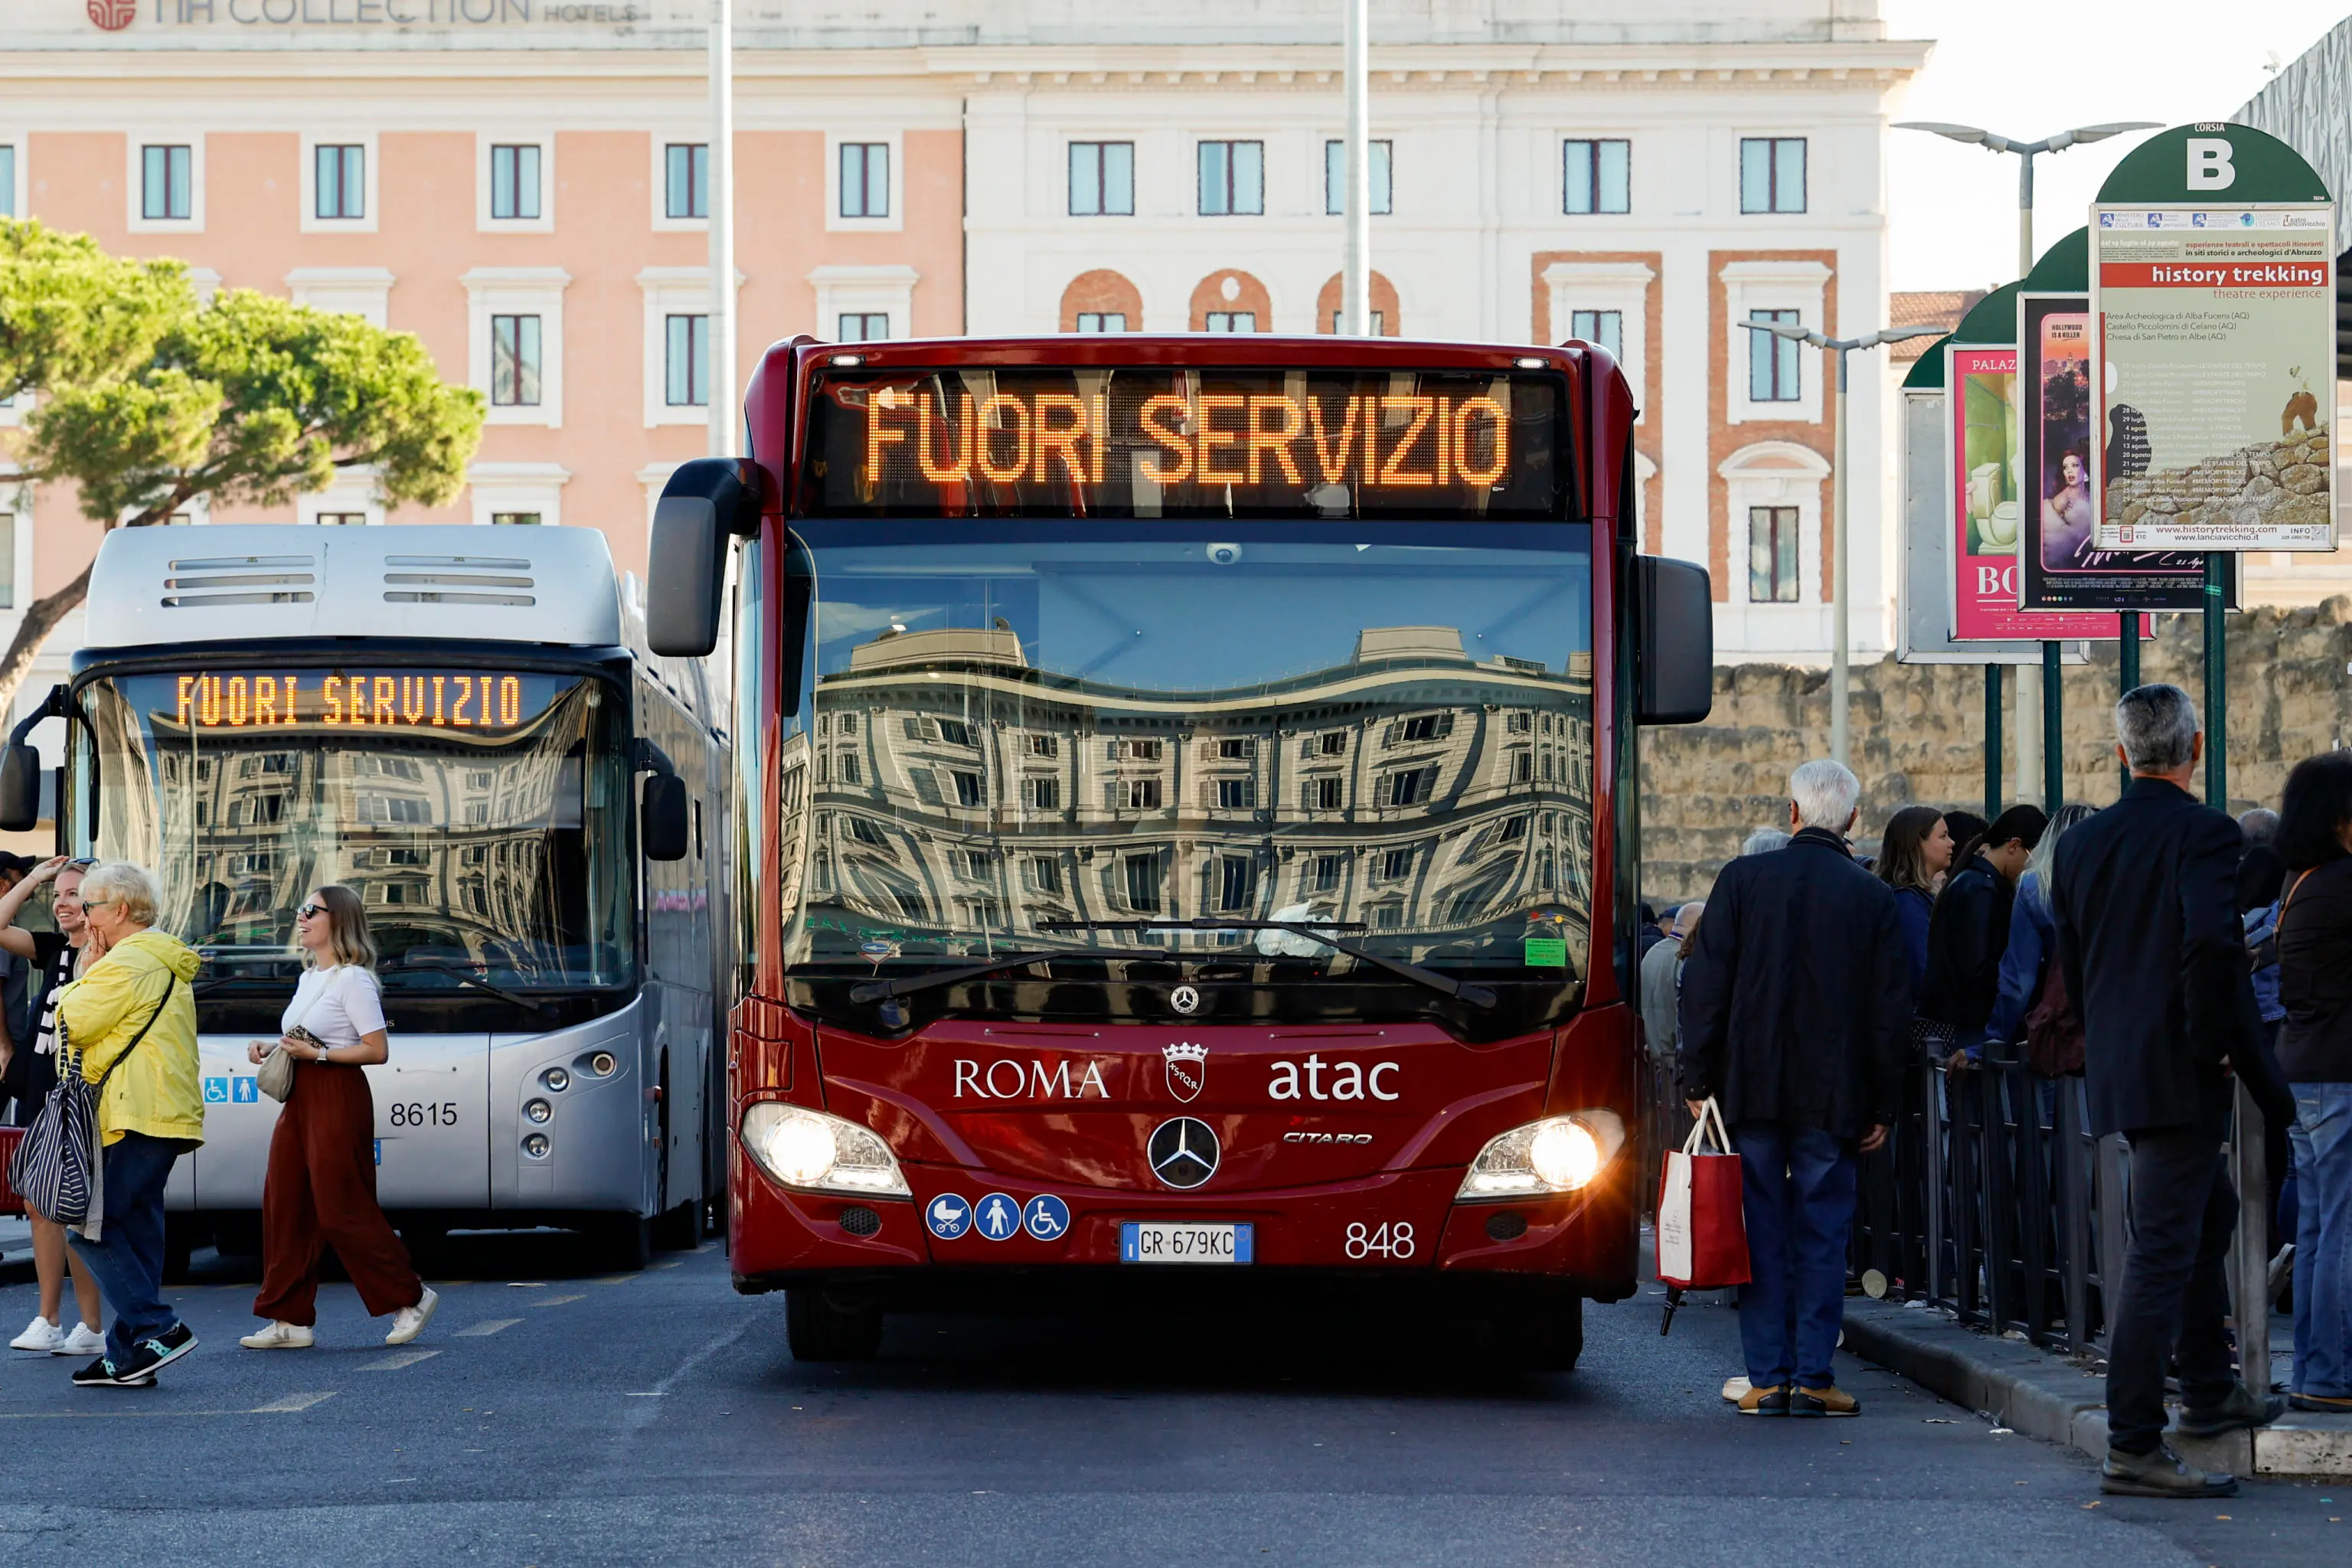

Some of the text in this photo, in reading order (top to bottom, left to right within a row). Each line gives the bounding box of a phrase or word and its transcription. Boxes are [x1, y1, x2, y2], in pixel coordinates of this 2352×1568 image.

[544, 5, 637, 23] HOTELS
[2194, 123, 2226, 132] CORSIA
[2187, 139, 2236, 190] B
[2237, 249, 2282, 257] archeologici
[2152, 266, 2323, 286] history trekking
[2213, 289, 2321, 300] theatre experience
[2125, 312, 2174, 321] Archeologica
[2218, 322, 2236, 331] (AQ)
[2208, 333, 2226, 341] (AQ)
[867, 394, 1509, 485] FUORI SERVIZIO
[2156, 525, 2277, 534] www.historytrekking.com
[177, 676, 520, 726] FUORI SERVIZIO
[952, 1060, 1111, 1099] ROMA
[1174, 1067, 1198, 1089] SPQR
[1268, 1054, 1400, 1101] atac
[390, 1102, 457, 1126] 8615
[1283, 1132, 1373, 1145] CITARO
[1345, 1222, 1415, 1259] 848
